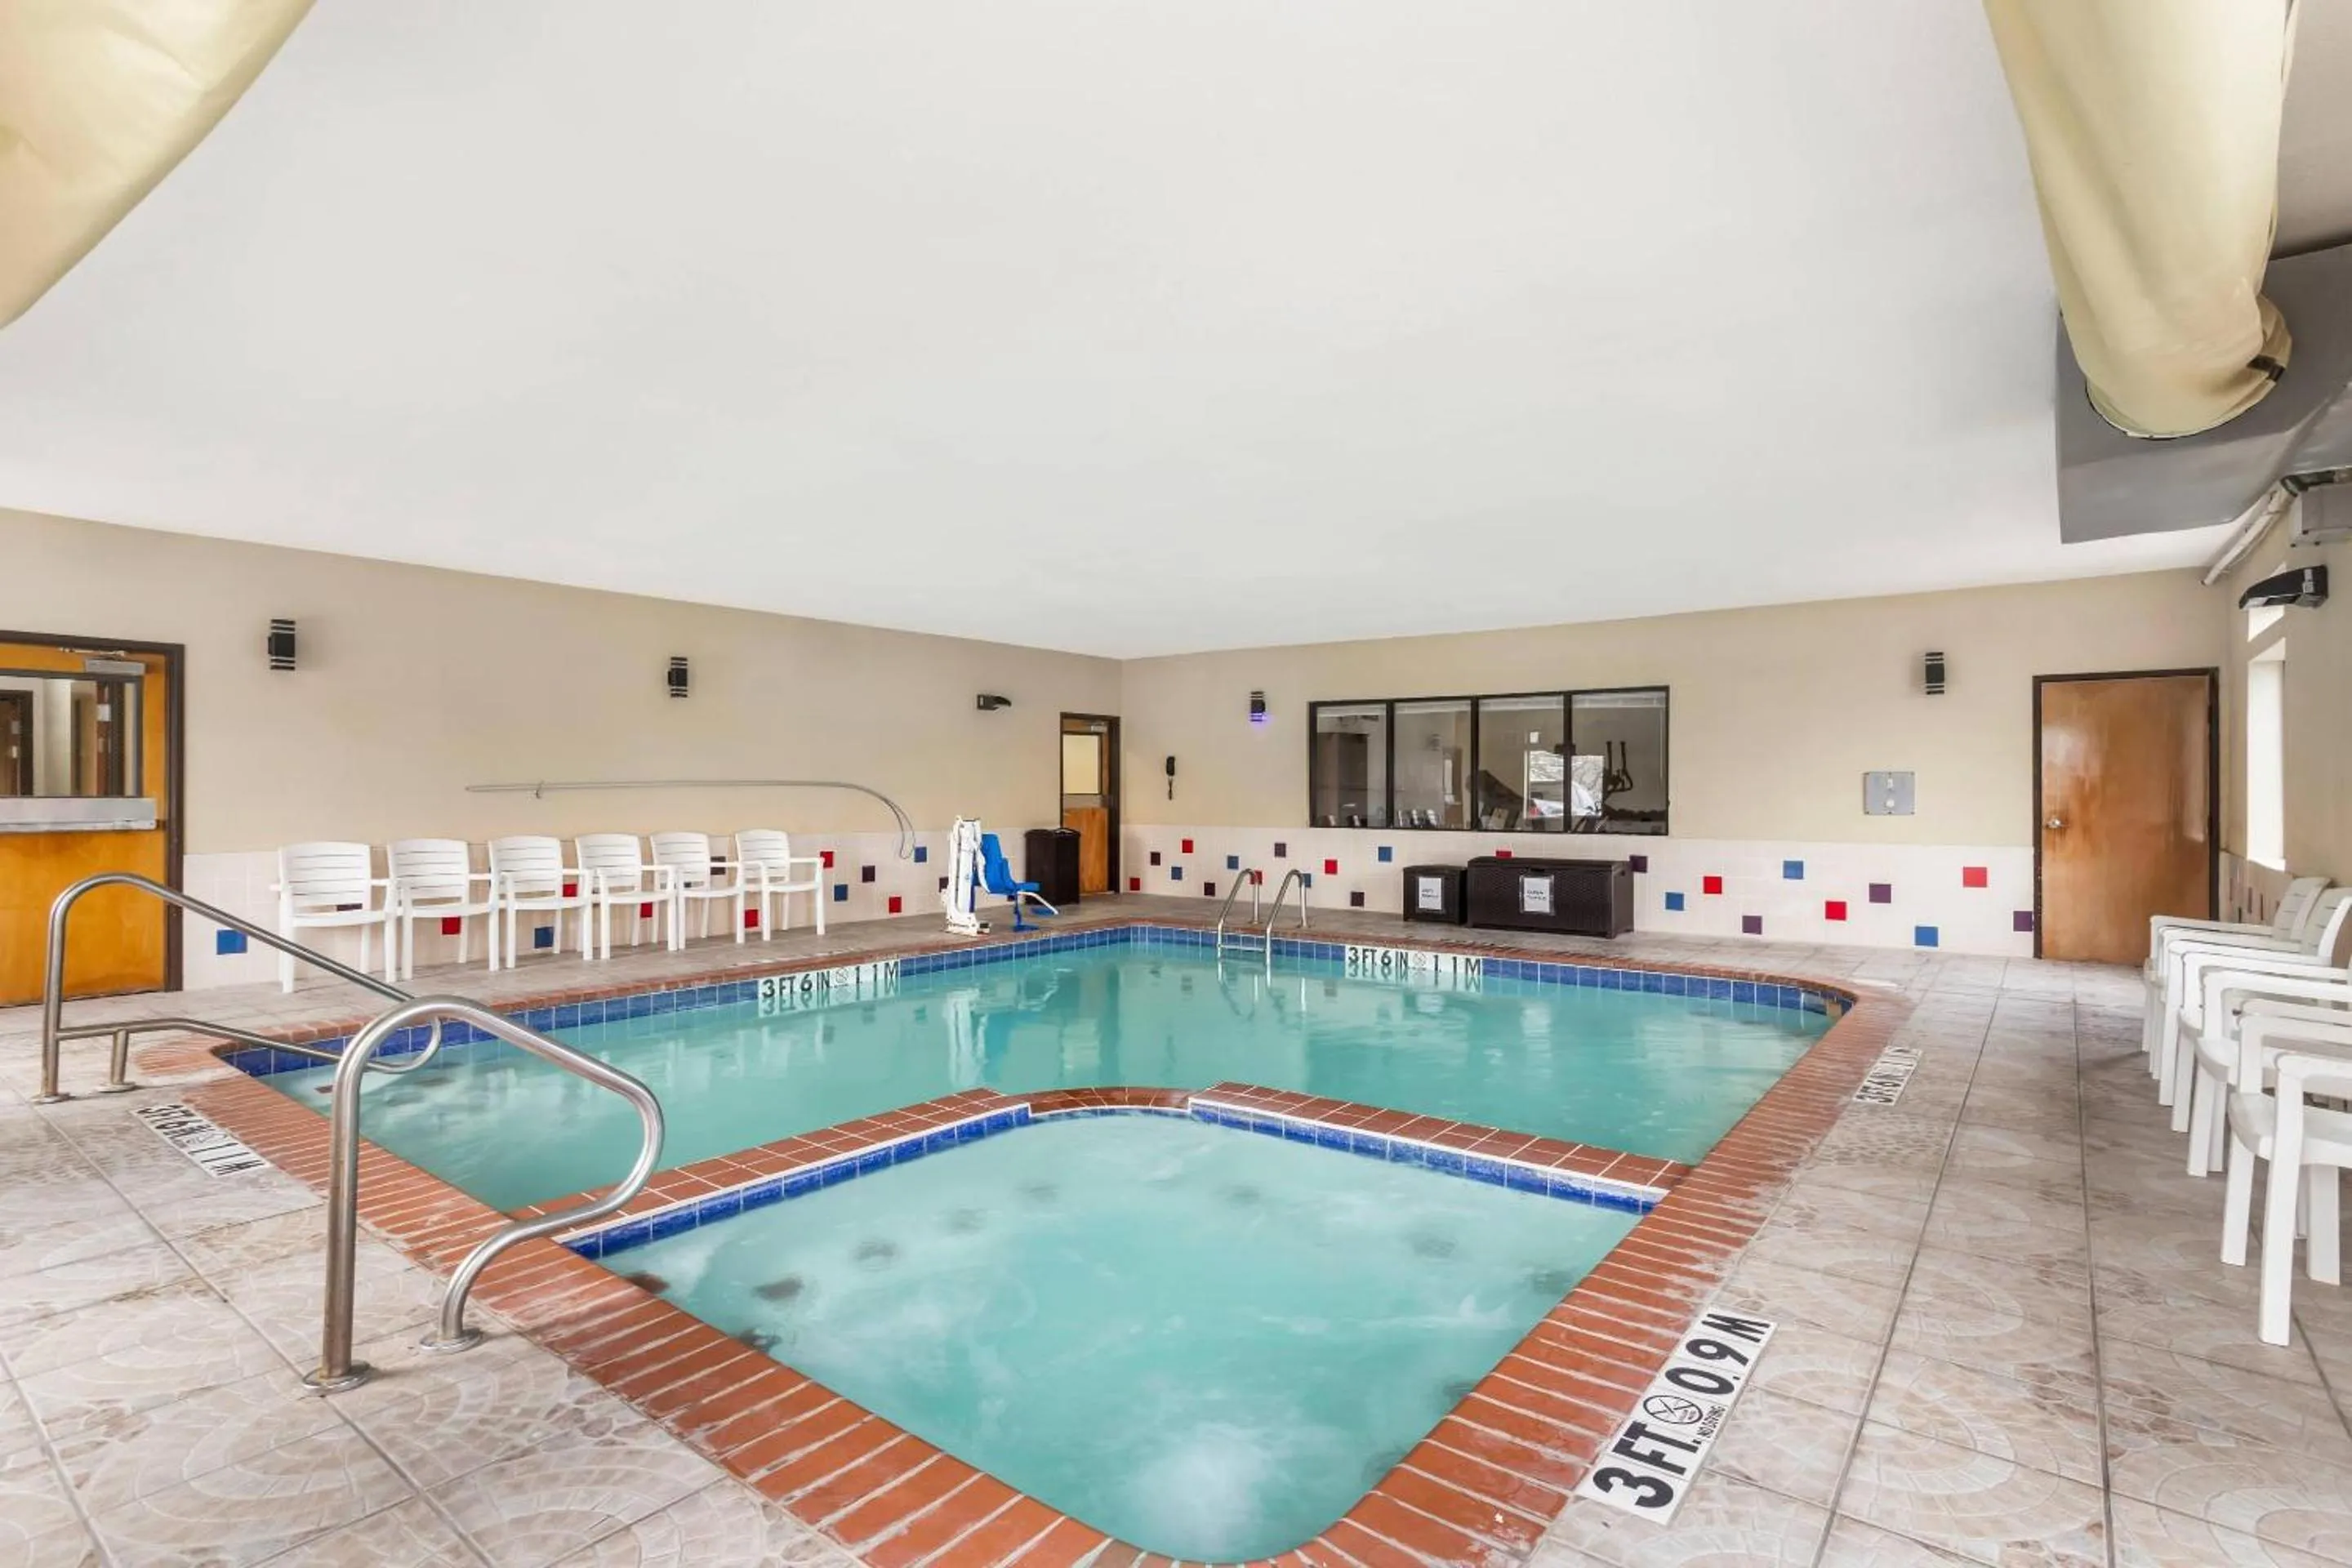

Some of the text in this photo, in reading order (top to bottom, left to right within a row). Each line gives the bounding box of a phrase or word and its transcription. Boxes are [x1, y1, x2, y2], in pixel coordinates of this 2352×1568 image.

[762, 978, 775, 998] 3
[800, 973, 813, 991] 6
[817, 970, 831, 991] IN
[884, 961, 898, 979] M
[1348, 947, 1359, 964] 3
[1381, 950, 1392, 965] 6
[1395, 951, 1409, 967] IN
[1465, 957, 1481, 975] M
[1701, 1313, 1770, 1343] M
[1665, 1339, 1748, 1395] 0.9
[1593, 1468, 1673, 1508] 3
